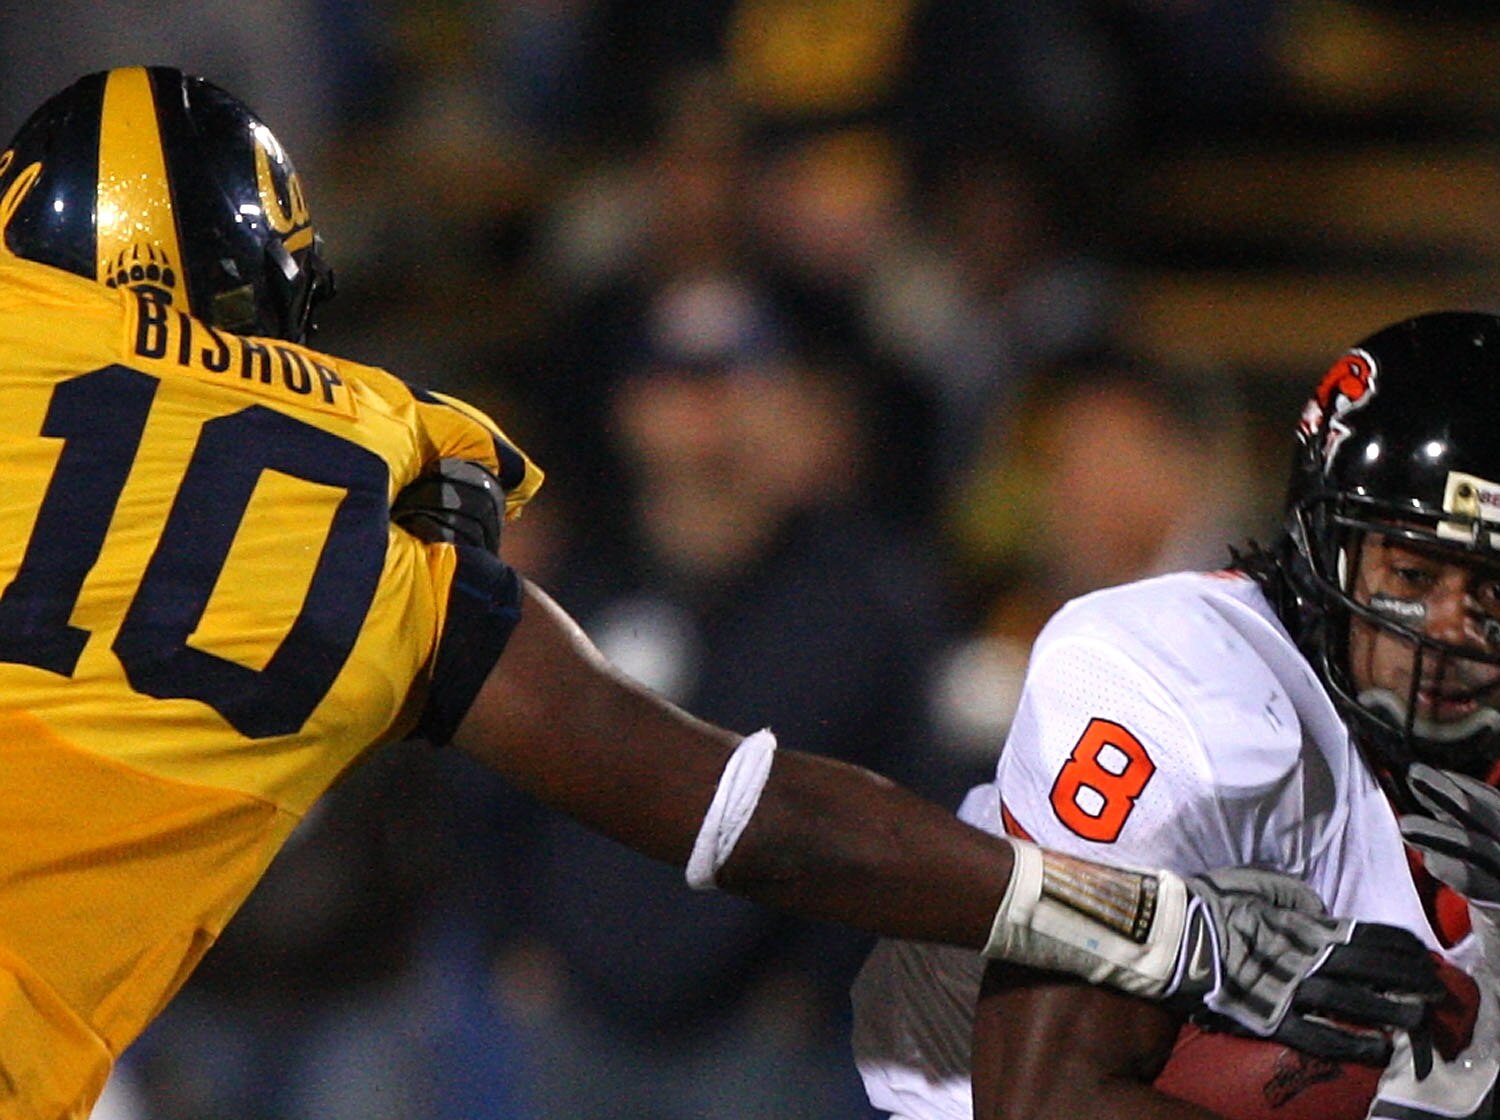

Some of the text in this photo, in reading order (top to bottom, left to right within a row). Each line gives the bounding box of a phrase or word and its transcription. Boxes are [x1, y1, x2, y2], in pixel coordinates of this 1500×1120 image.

[134, 291, 344, 405] BISHOP
[0, 363, 391, 741] 10
[1048, 717, 1157, 844] 8
